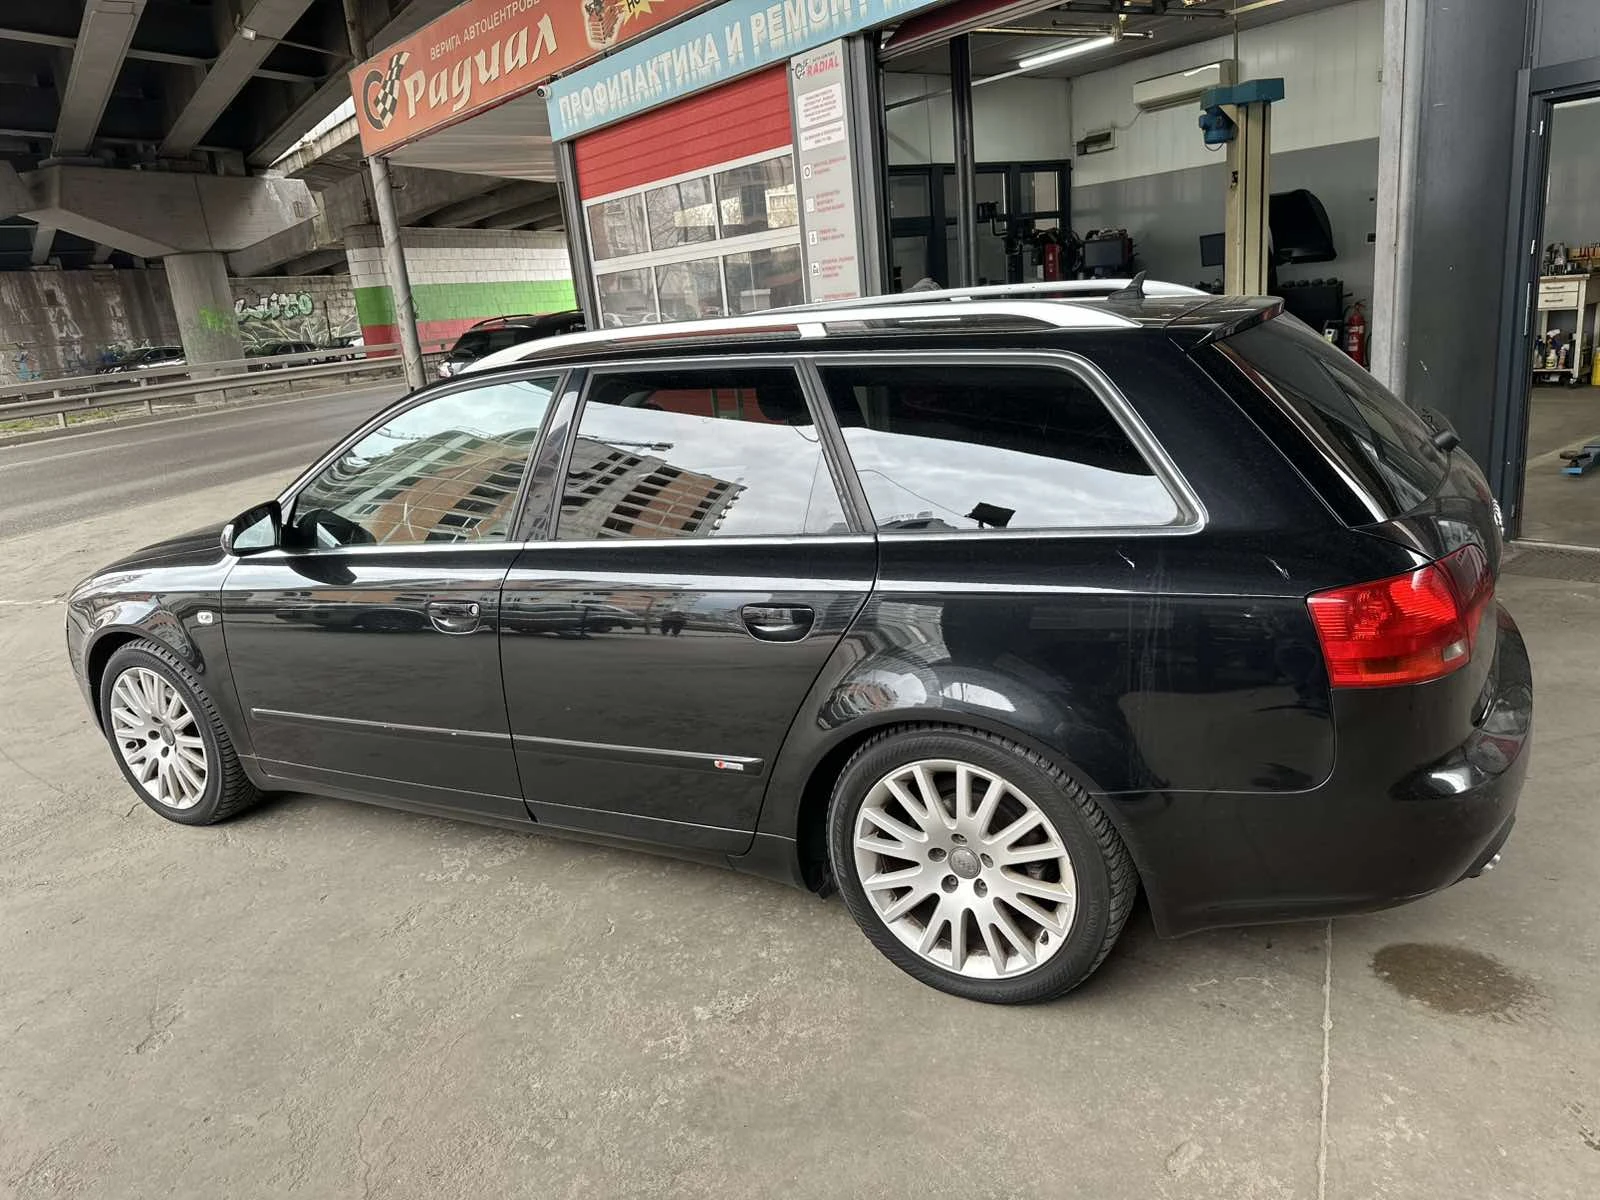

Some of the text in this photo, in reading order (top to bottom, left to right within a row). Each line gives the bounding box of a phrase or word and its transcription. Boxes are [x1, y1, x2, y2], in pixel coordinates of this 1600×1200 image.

[404, 13, 559, 120] Радиал
[430, 33, 461, 60] ВЕРИГА
[558, 0, 869, 124] ПРОФИЛАКТИКА И РЕМО
[806, 55, 839, 77] RADIAL
